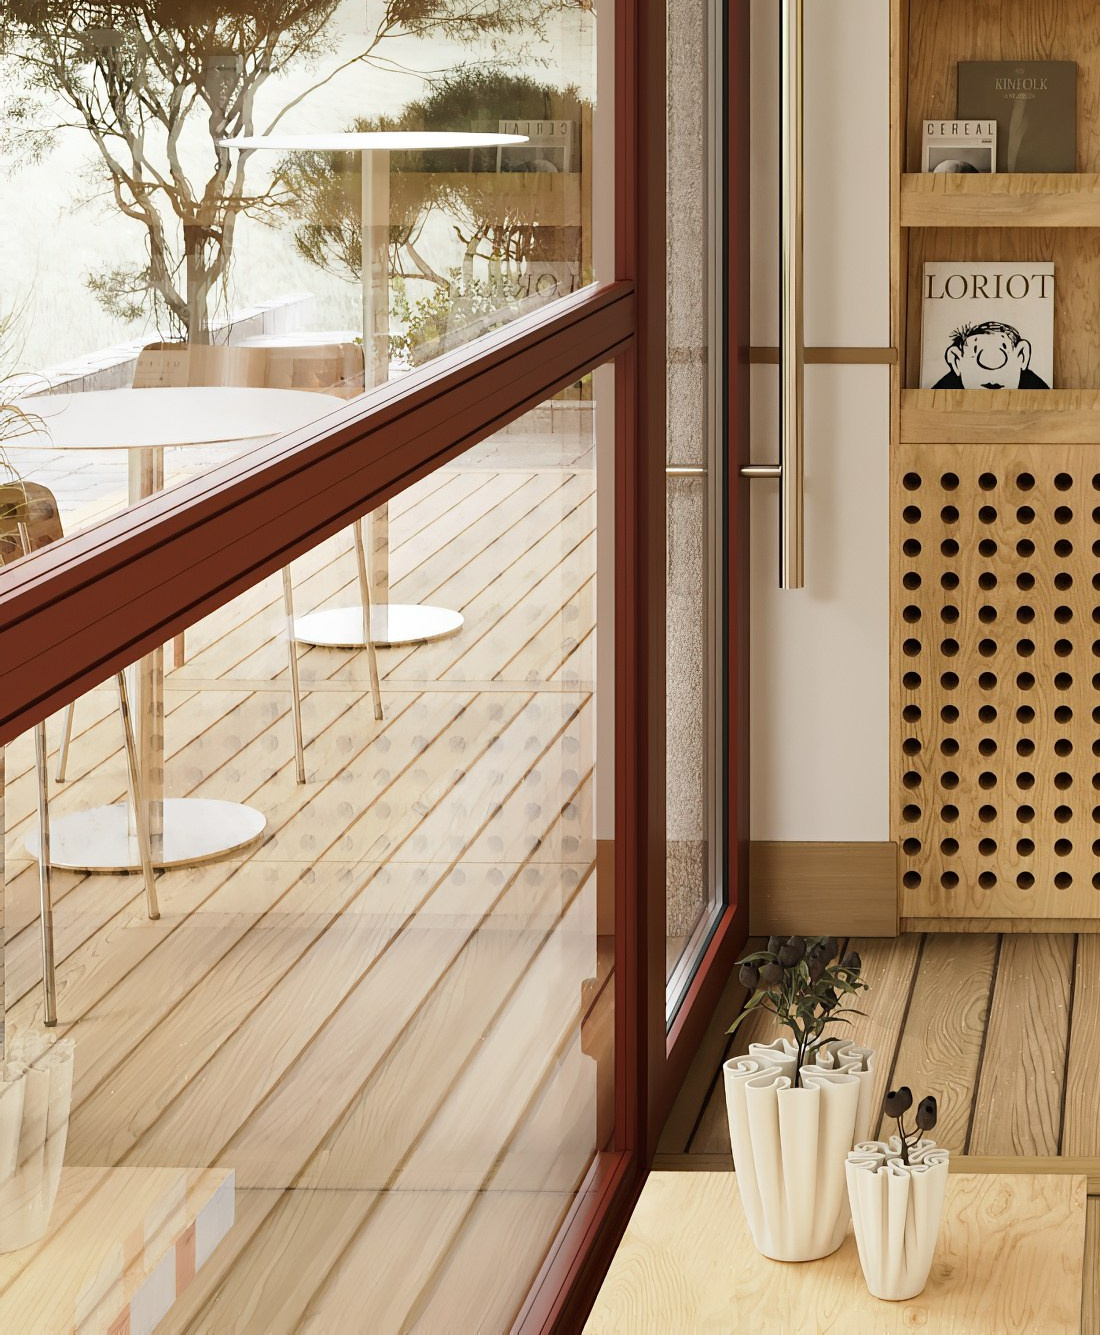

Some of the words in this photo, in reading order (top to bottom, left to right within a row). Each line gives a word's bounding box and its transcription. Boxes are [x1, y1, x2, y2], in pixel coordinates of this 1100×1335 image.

[995, 78, 1048, 91] KINFOLK
[927, 123, 994, 136] CEREAL
[925, 274, 1053, 300] LORIOT
